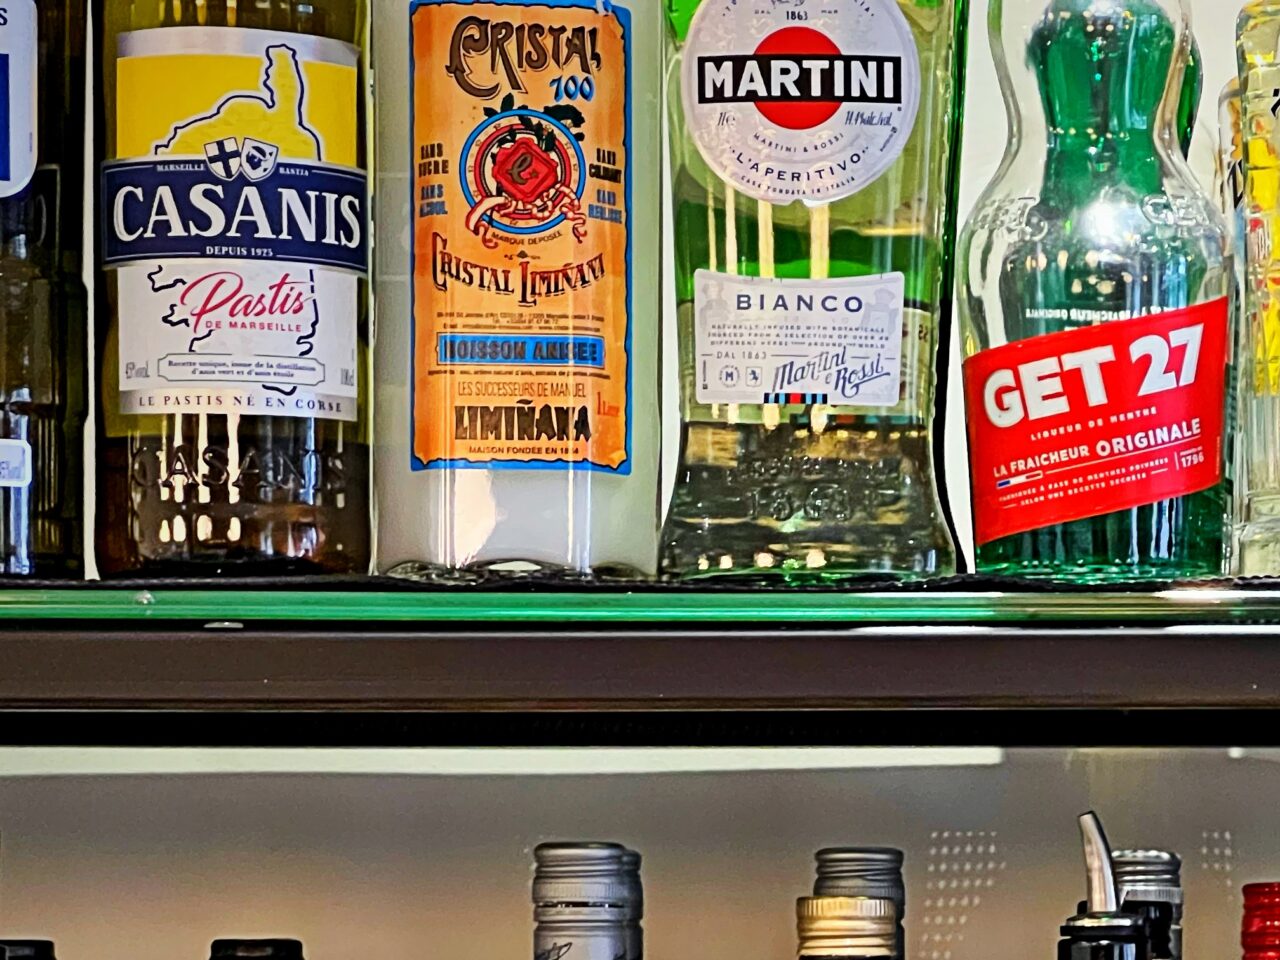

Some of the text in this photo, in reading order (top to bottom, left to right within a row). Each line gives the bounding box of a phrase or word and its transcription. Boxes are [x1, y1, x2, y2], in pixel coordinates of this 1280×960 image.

[786, 11, 808, 21] 1863
[550, 75, 595, 102] 100
[705, 60, 894, 98] MARTINI
[753, 133, 844, 153] MARTINI ROSSI
[737, 152, 861, 182] L'APERITIVO
[113, 184, 360, 248] CASANIS
[206, 246, 247, 255] DEPUIS
[180, 271, 315, 333] Pastis
[737, 294, 863, 312] BIANCO
[206, 320, 302, 332] DE MARSEILLE
[984, 323, 1204, 428] GET 27
[458, 381, 472, 396] LES
[537, 382, 549, 397] DE
[139, 396, 154, 407] LE
[164, 395, 223, 406] PASTIS
[266, 397, 285, 407] EN
[296, 399, 342, 412] CORSE
[1031, 423, 1082, 441] LIQUEUR
[1088, 417, 1104, 428] DE
[994, 417, 1201, 477] LA FRAICHEUR ORIGINALE
